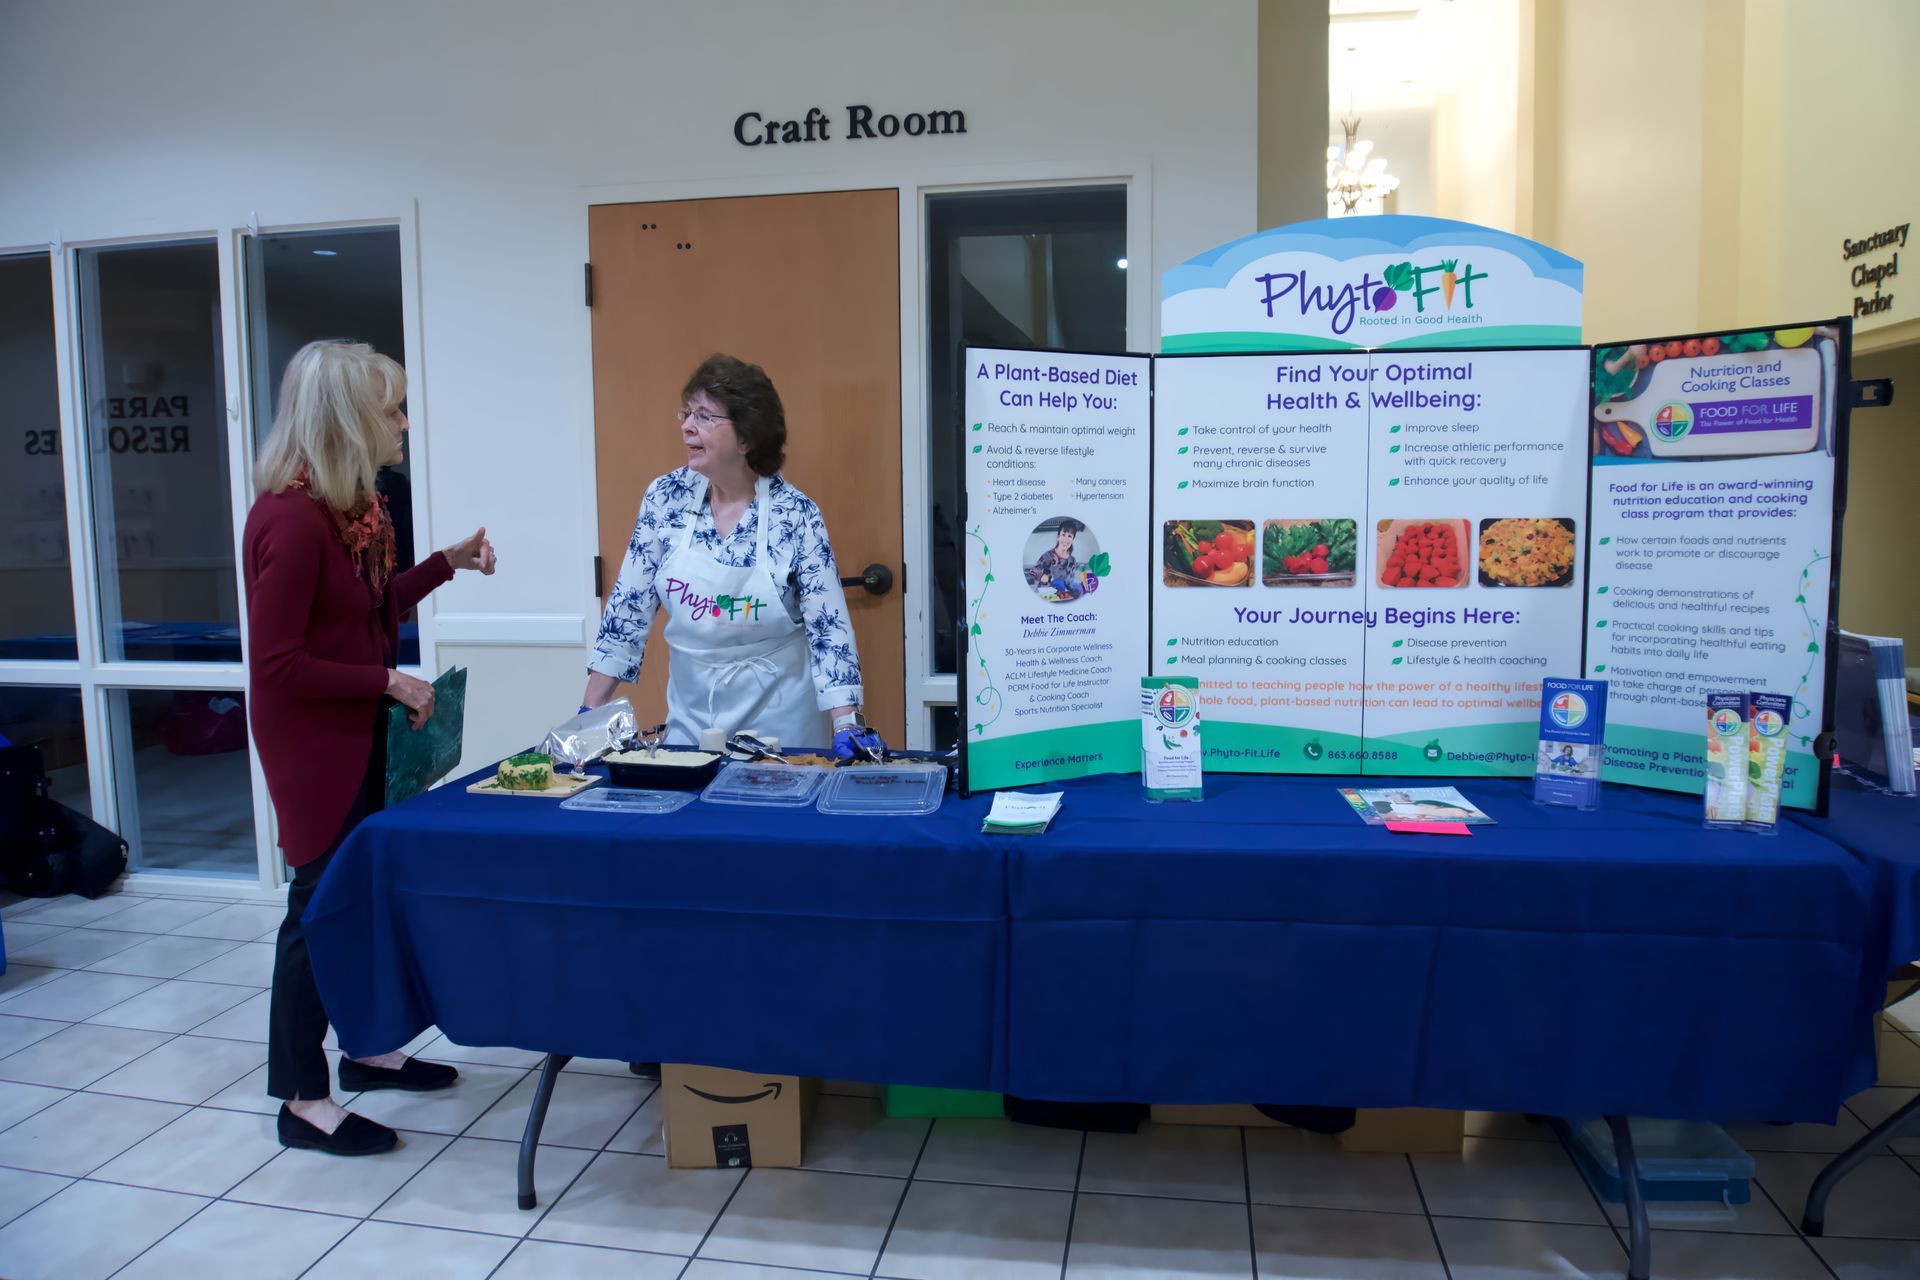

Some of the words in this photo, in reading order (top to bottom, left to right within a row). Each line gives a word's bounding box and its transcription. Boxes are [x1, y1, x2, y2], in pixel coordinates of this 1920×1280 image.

[734, 108, 830, 146] Craft
[846, 105, 967, 139] Room
[1843, 223, 1910, 260] Sanctuary
[1851, 253, 1898, 288] Chapel
[1853, 291, 1894, 318] Parlor
[1360, 317, 1397, 325] Rooted
[1415, 315, 1443, 324] Good
[1448, 314, 1482, 324] Health
[977, 363, 989, 379] A
[996, 364, 1099, 384] Plant-Based
[1106, 370, 1137, 385] Diet
[1277, 365, 1320, 383] Find
[1329, 365, 1379, 382] Your
[1386, 363, 1472, 384] Optimal
[1690, 364, 1752, 378] Nutrition
[1757, 360, 1781, 373] and
[1681, 377, 1736, 393] Cooking
[1740, 375, 1790, 389] Classes
[1000, 390, 1032, 406] Can
[1040, 392, 1077, 412] Help
[1083, 393, 1117, 409] You:
[1267, 392, 1337, 410] Health
[1345, 392, 1360, 408] &
[1371, 391, 1481, 411] Wellbeing:
[1700, 405, 1737, 417] FOOD
[1742, 404, 1768, 415] FOR
[1773, 402, 1797, 413] LIFE
[988, 423, 1017, 433] Reach
[1020, 424, 1026, 433] &
[1030, 424, 1068, 434] maintain
[1072, 426, 1104, 436] optimal
[1108, 427, 1135, 437] weight
[1193, 426, 1216, 435] Take
[1220, 425, 1256, 434] control
[1259, 425, 1269, 434] of
[1273, 424, 1296, 435] your
[1300, 423, 1332, 433] health
[1405, 424, 1448, 433] Improve
[1452, 424, 1479, 432] sleep
[987, 445, 1012, 455] Avoid
[1016, 446, 1022, 454] &
[1061, 446, 1094, 458] lifestyle
[1194, 446, 1234, 455] Prevent,
[1278, 445, 1286, 454] &
[1290, 445, 1326, 454] survive
[1404, 443, 1449, 452] Increase
[1452, 443, 1490, 452] athletic
[1494, 442, 1564, 452] performance
[987, 459, 1036, 469] conditions:
[1193, 460, 1222, 470] many
[1226, 459, 1262, 468] chronic
[1266, 458, 1310, 467] diseases
[1404, 457, 1425, 466] with
[1429, 456, 1456, 466] quick
[1460, 457, 1506, 466] recovery
[1017, 478, 1046, 486] disease
[1076, 478, 1096, 487] Many
[1192, 480, 1239, 488] Maximize
[1242, 479, 1269, 488] brain
[1272, 478, 1314, 488] function
[1404, 476, 1449, 486] Enhance
[1452, 477, 1476, 487] your
[1480, 476, 1515, 486] quality
[1519, 475, 1530, 484] of
[1533, 475, 1548, 484] life
[1610, 484, 1637, 492] Food
[1641, 482, 1658, 492] for
[1662, 482, 1683, 491] Life
[1687, 481, 1695, 491] is
[1700, 482, 1714, 490] an
[1718, 479, 1813, 491] award-winning
[993, 493, 1012, 502] Type
[1021, 492, 1053, 501] diabetes
[1076, 492, 1124, 501] Hypertension
[1614, 496, 1661, 506] nutrition
[1665, 495, 1724, 505] education
[1729, 494, 1752, 503] and
[1756, 492, 1808, 504] cooking
[993, 506, 1036, 514] Alzheimer's
[1622, 509, 1648, 518] class
[1652, 509, 1705, 520] program
[1709, 508, 1734, 518] that
[1738, 507, 1796, 519] provides:
[1617, 536, 1638, 545] How
[1642, 536, 1676, 545] certain
[1680, 536, 1709, 545] foods
[1713, 536, 1734, 545] and
[1737, 536, 1786, 545] nutrients
[1021, 615, 1044, 624] Meet
[1048, 614, 1064, 623] The
[1067, 612, 1098, 622] Coach:
[1234, 607, 1282, 624] Your
[1289, 607, 1377, 628] Journey
[1385, 607, 1455, 628] Begins
[1464, 608, 1520, 624] Here:
[1023, 629, 1048, 638] Debbie
[1051, 627, 1096, 637] Zimmerman
[1182, 637, 1224, 646] Nutrition
[1228, 637, 1278, 646] education
[1407, 638, 1448, 648] Disease
[1451, 639, 1506, 648] prevention
[1005, 647, 1036, 656] 30-Years
[1046, 644, 1081, 654] Corporate
[1181, 655, 1205, 664] Meal
[1208, 656, 1252, 666] planning
[1266, 657, 1306, 666] cooking
[1310, 657, 1347, 665] classes
[1407, 656, 1450, 666] Lifestyle
[1453, 656, 1461, 664] &
[1464, 656, 1496, 664] health
[1500, 656, 1547, 666] coaching
[1028, 670, 1056, 679] Lifestyle
[1059, 668, 1088, 676] Medicine
[1031, 682, 1049, 690] Food
[1077, 678, 1110, 687] Instructor
[1037, 693, 1066, 702] Cooking
[1015, 708, 1038, 716] Sports
[1040, 704, 1069, 713] Nutrition
[1071, 702, 1103, 712] Specialist
[1016, 757, 1064, 769] Experience
[1068, 752, 1103, 763] Matters
[1328, 751, 1398, 760] 863.660.8588
[1448, 752, 1536, 762] Debbie@Phyto-
